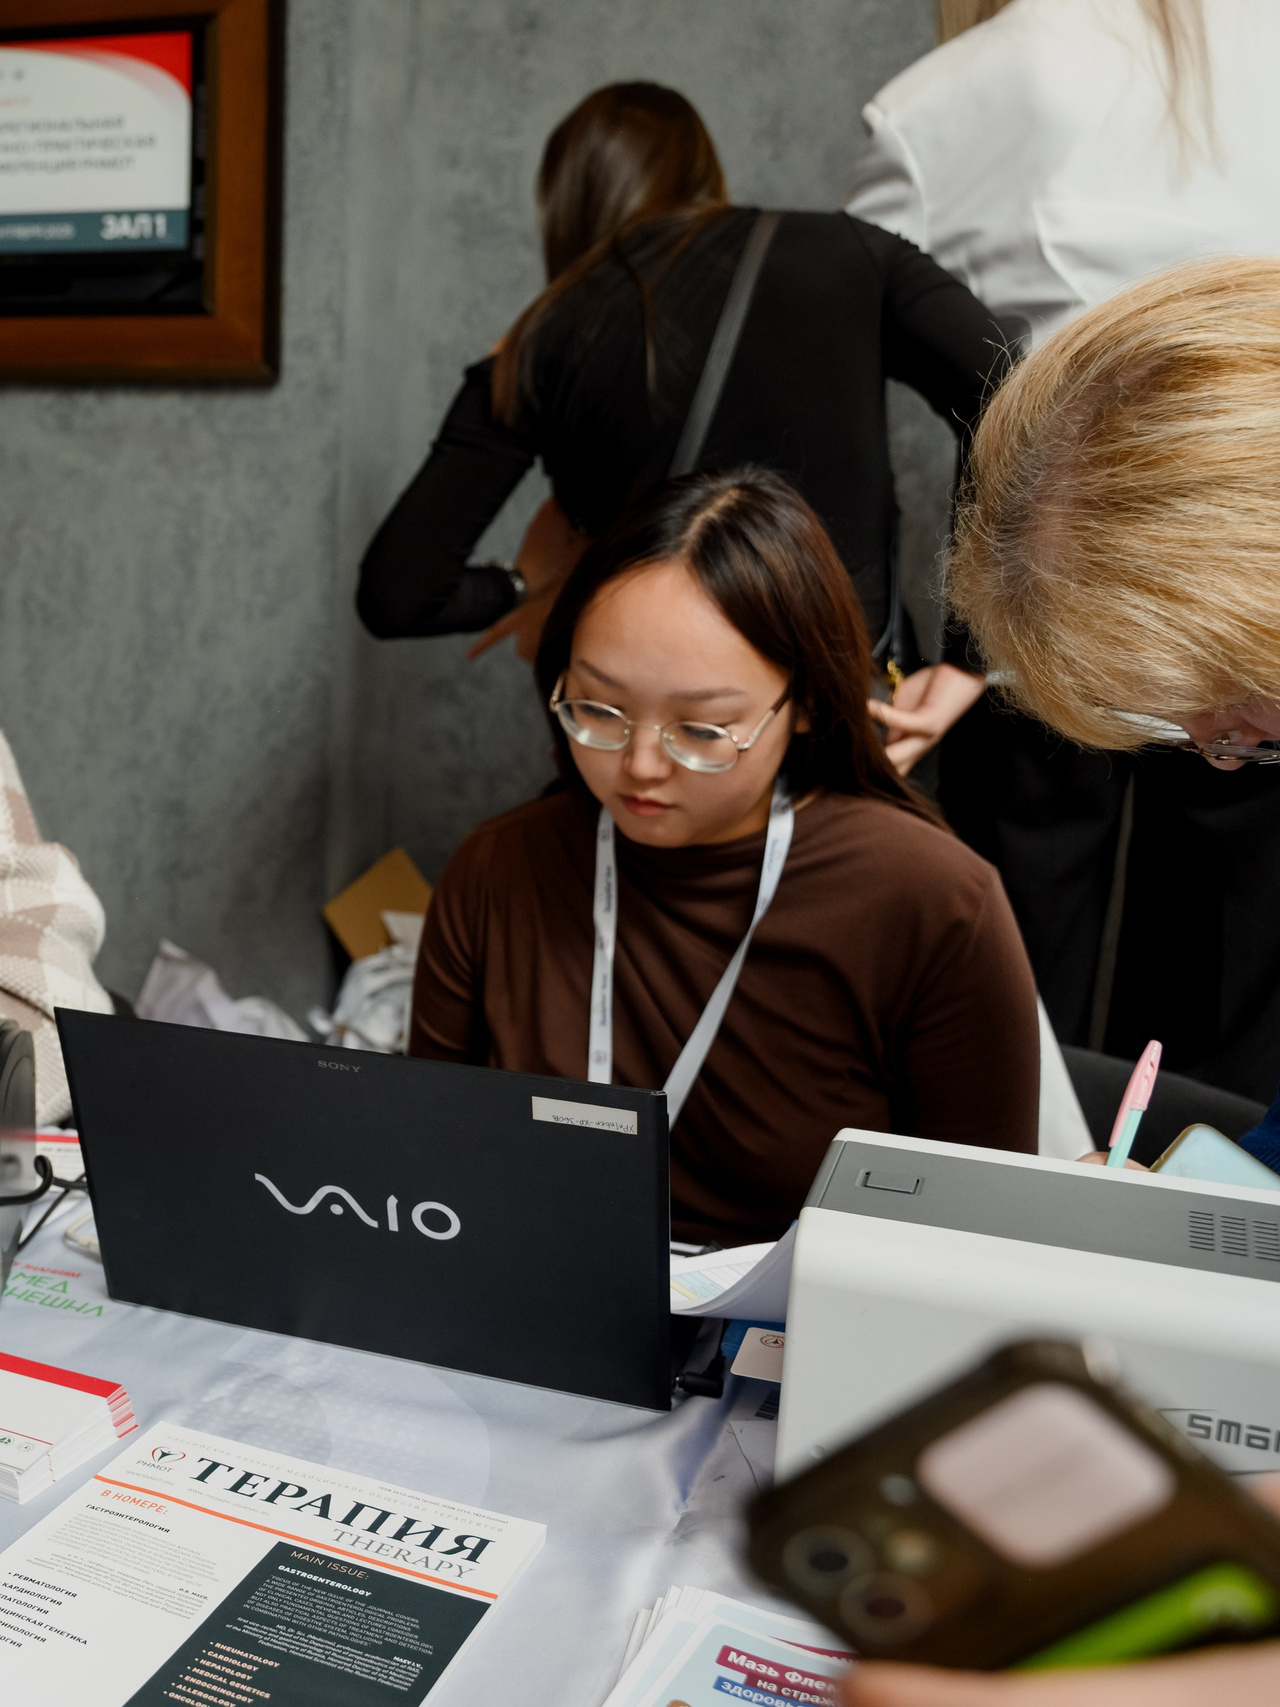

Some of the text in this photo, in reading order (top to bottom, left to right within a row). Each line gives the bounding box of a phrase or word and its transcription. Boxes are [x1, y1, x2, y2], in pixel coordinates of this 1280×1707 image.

[318, 1060, 361, 1073] SONY
[254, 1173, 461, 1240] VAIO
[1, 1284, 105, 1317] НЕШНЛ
[135, 1459, 173, 1473] РНМОТ
[166, 1435, 504, 1533] РОССИЙСКОЕ НАУЧНОЕ МЕДИЦИНСКОЕ ОБЩЕСТВО ТЕРАПЕВТОВ
[99, 1489, 171, 1515] В НОМЕРЕ:
[190, 1457, 496, 1564] ТЕРАПИЯ
[85, 1503, 171, 1533] ГАСТРОЭНТЕРОЛОГИЯ
[289, 1550, 371, 1580] MAIN ISSUE:
[331, 1528, 475, 1579] THERAPY
[1, 1581, 63, 1606] КАРДИОЛОГИЯ
[12, 1572, 77, 1598] РЕВМАТОЛОГИЯ
[277, 1564, 371, 1597] GASTROENTEROLOGY
[285, 1585, 307, 1594] RANGE
[312, 1587, 327, 1595] NEW
[326, 1592, 345, 1600] ISSUE
[366, 1604, 395, 1616] JOURNAL
[42, 1624, 89, 1645] ГЕНЕТИКА
[206, 1650, 259, 1672] CARDIOLOGY
[213, 1641, 280, 1669] RHEUMATOLOGY
[727, 1651, 780, 1677] Мазь
[191, 1666, 271, 1699] MEDICAL GENETICS
[198, 1658, 253, 1681] HEPATOLOGY
[175, 1682, 236, 1707] ALLERGOLOGY
[183, 1674, 254, 1704] ENDOCRINOLOGY
[756, 1679, 837, 1706] на страж
